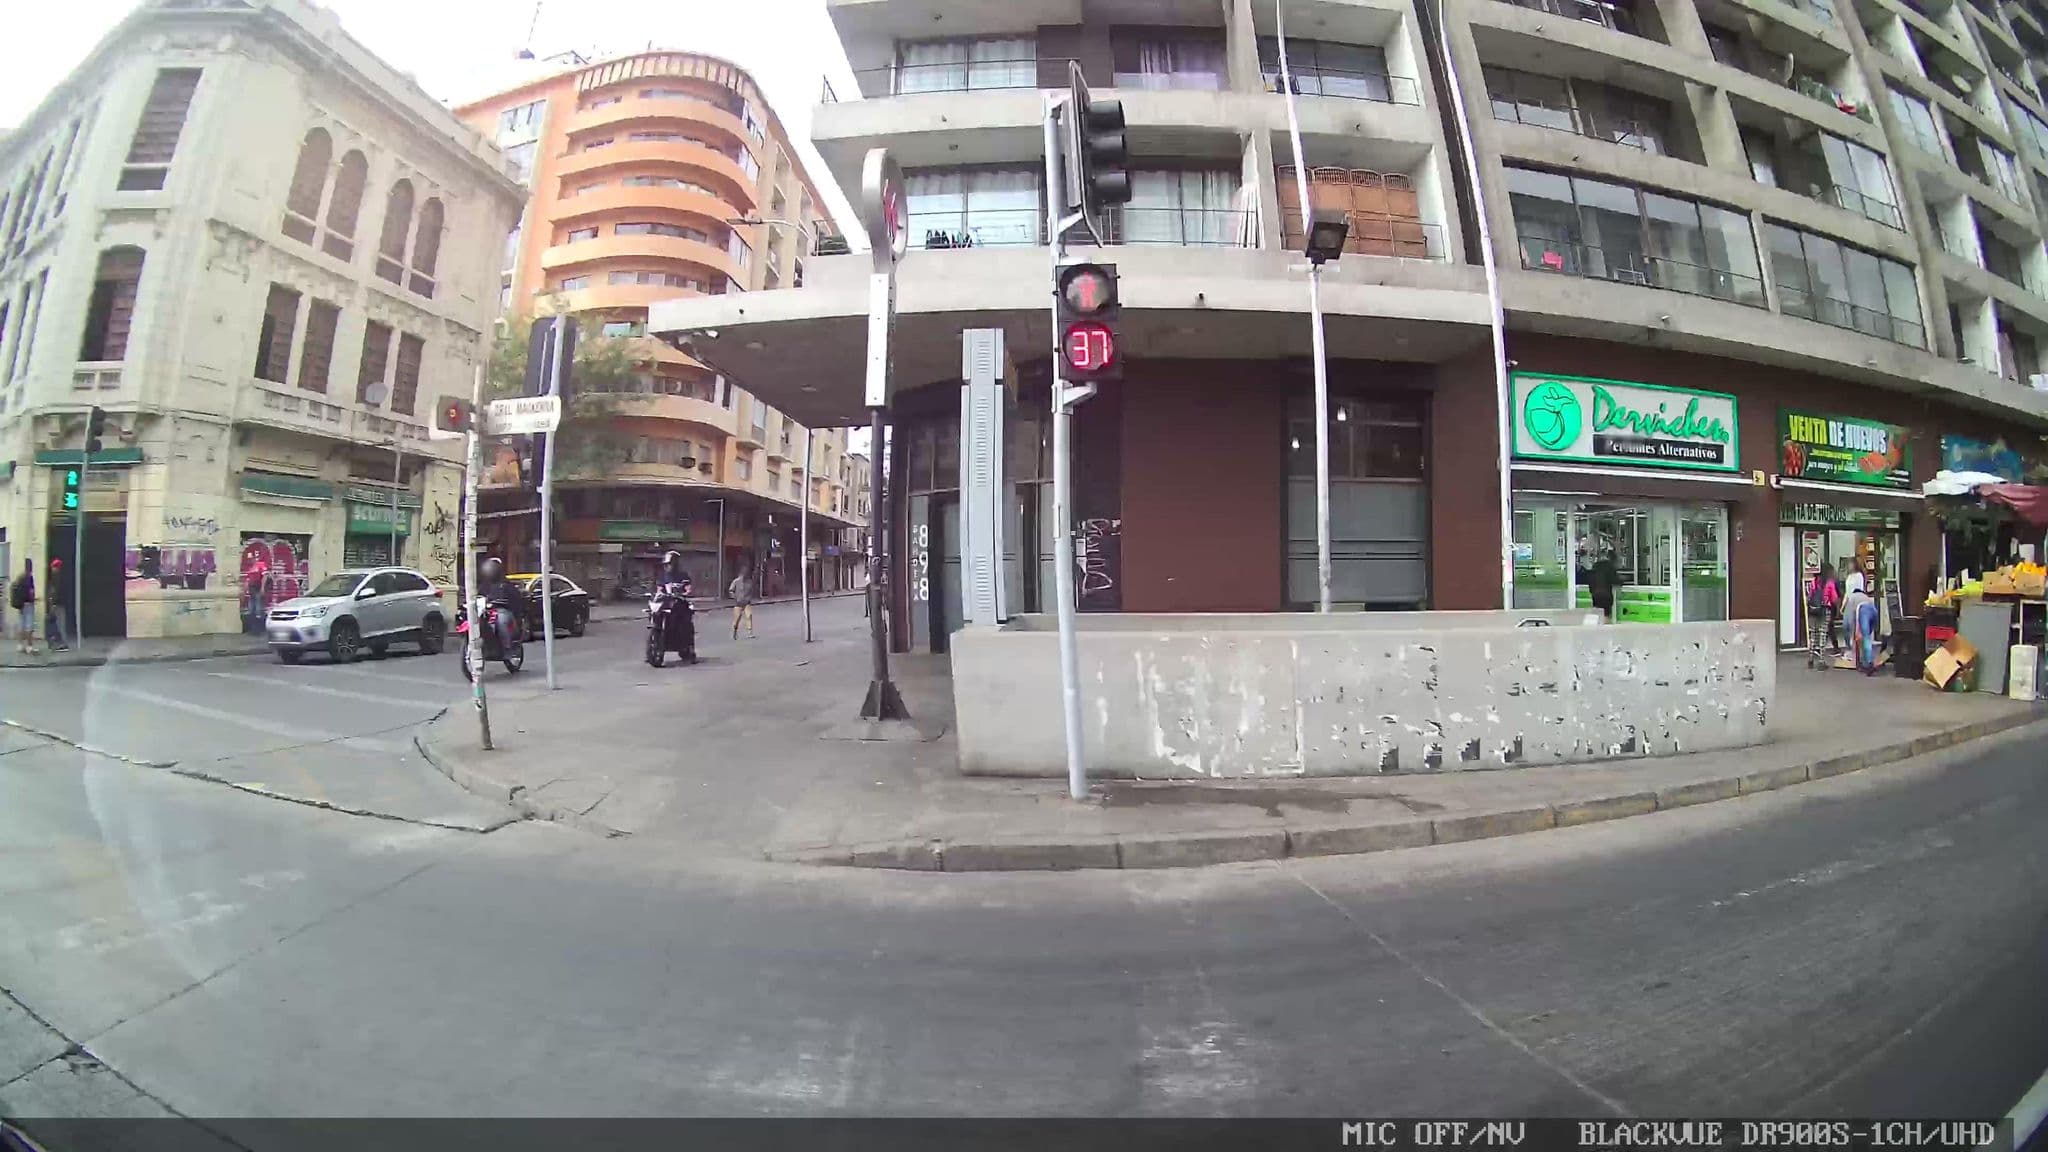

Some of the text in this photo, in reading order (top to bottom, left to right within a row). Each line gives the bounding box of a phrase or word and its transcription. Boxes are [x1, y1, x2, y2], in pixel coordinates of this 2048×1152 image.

[1072, 331, 1108, 366] 37
[1788, 414, 1828, 445] VENTA
[1828, 420, 1844, 448] DE
[1658, 444, 1718, 460] Alternativos
[919, 524, 929, 600] 898
